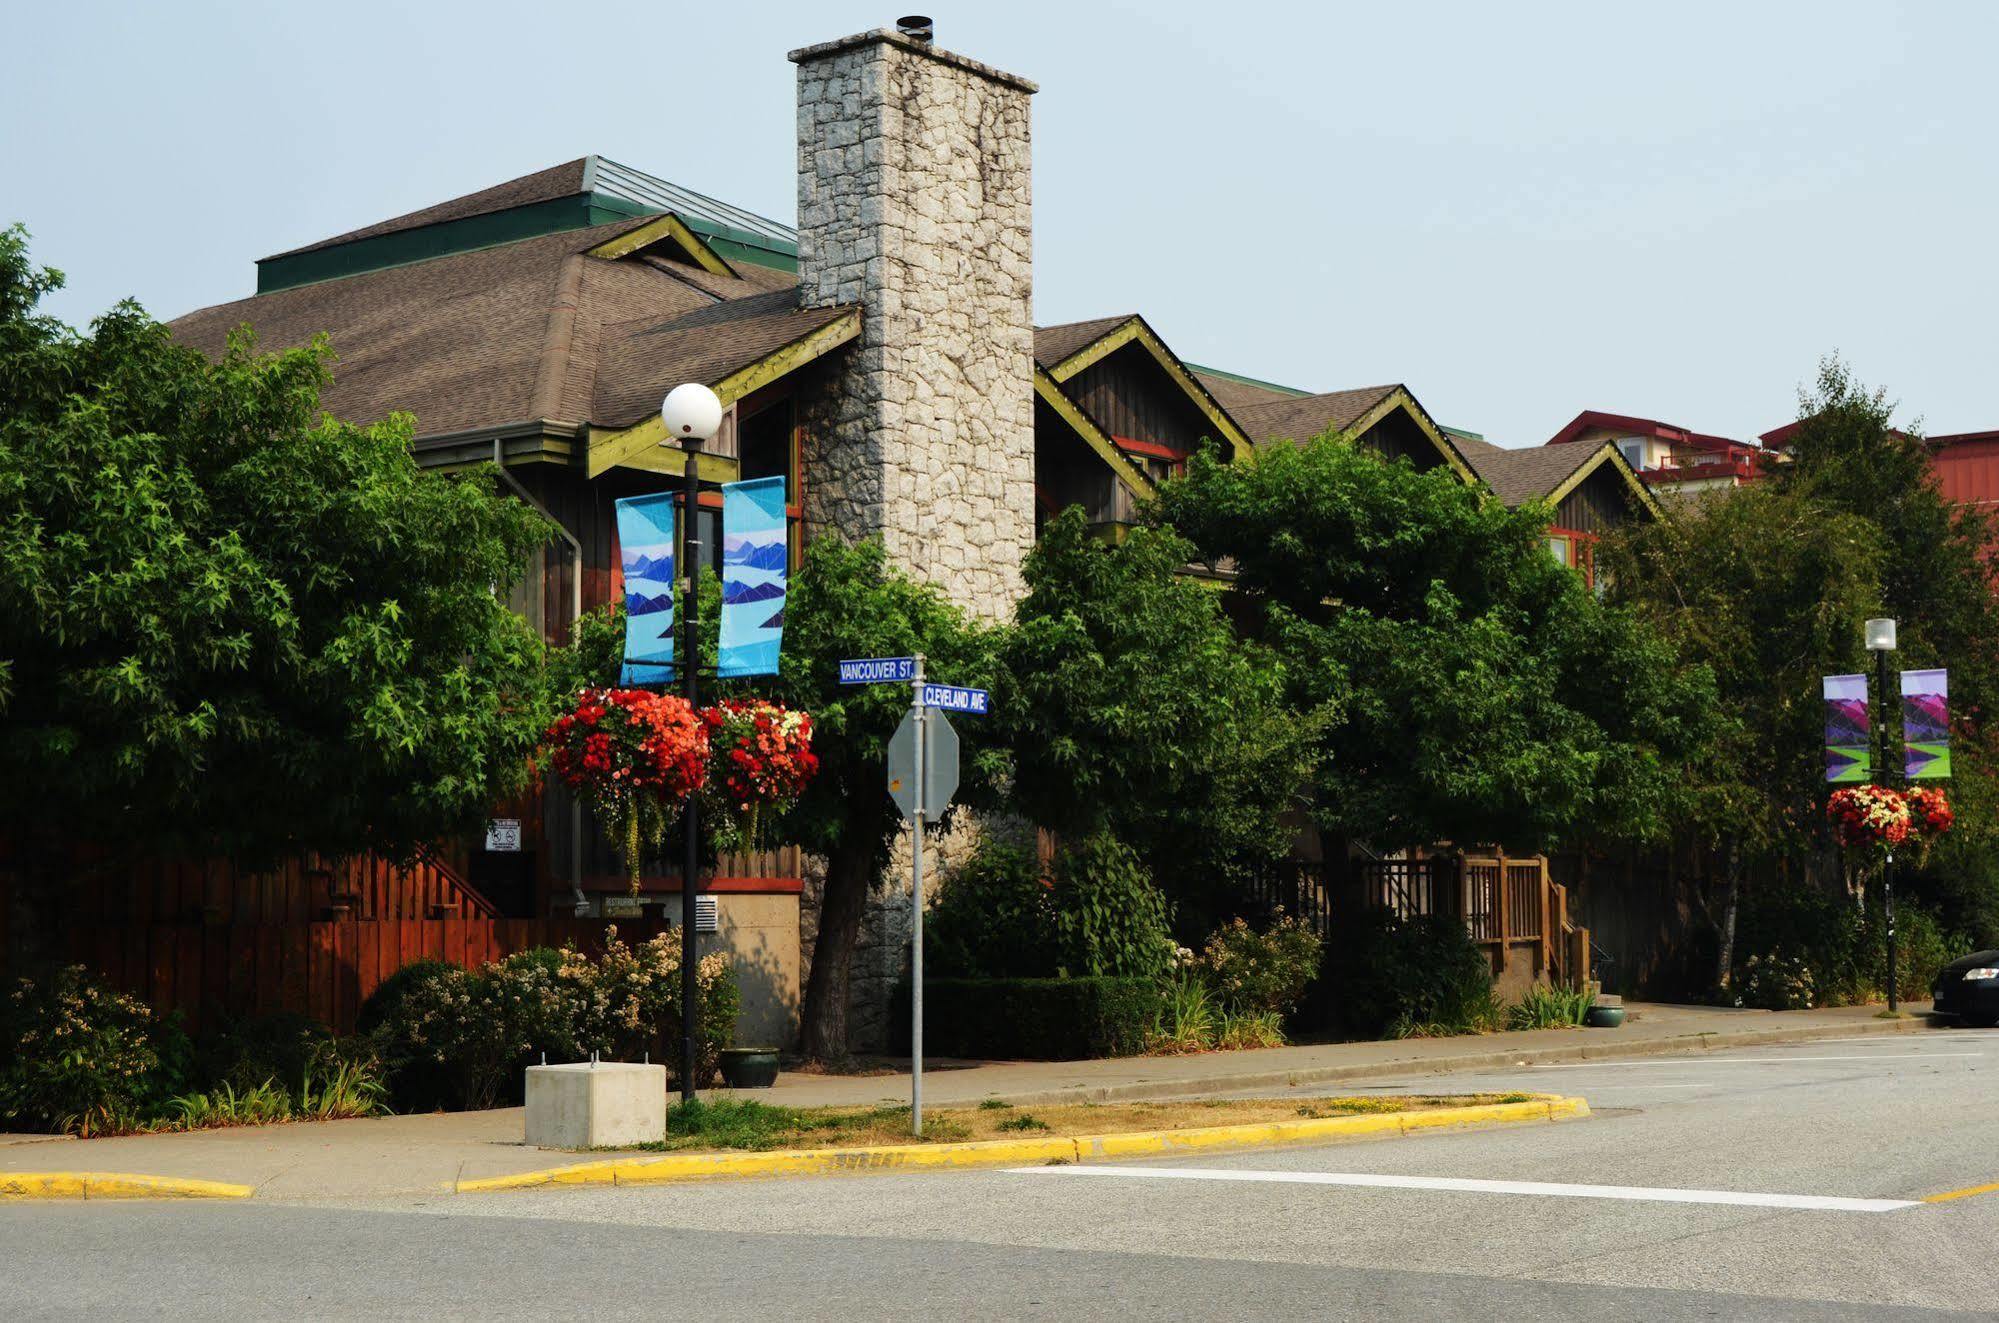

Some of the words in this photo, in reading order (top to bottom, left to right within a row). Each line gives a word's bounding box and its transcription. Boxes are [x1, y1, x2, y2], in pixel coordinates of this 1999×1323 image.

[840, 662, 896, 680] VANCOUVER
[925, 687, 968, 708] CLEVELAND
[970, 691, 985, 710] AVE
